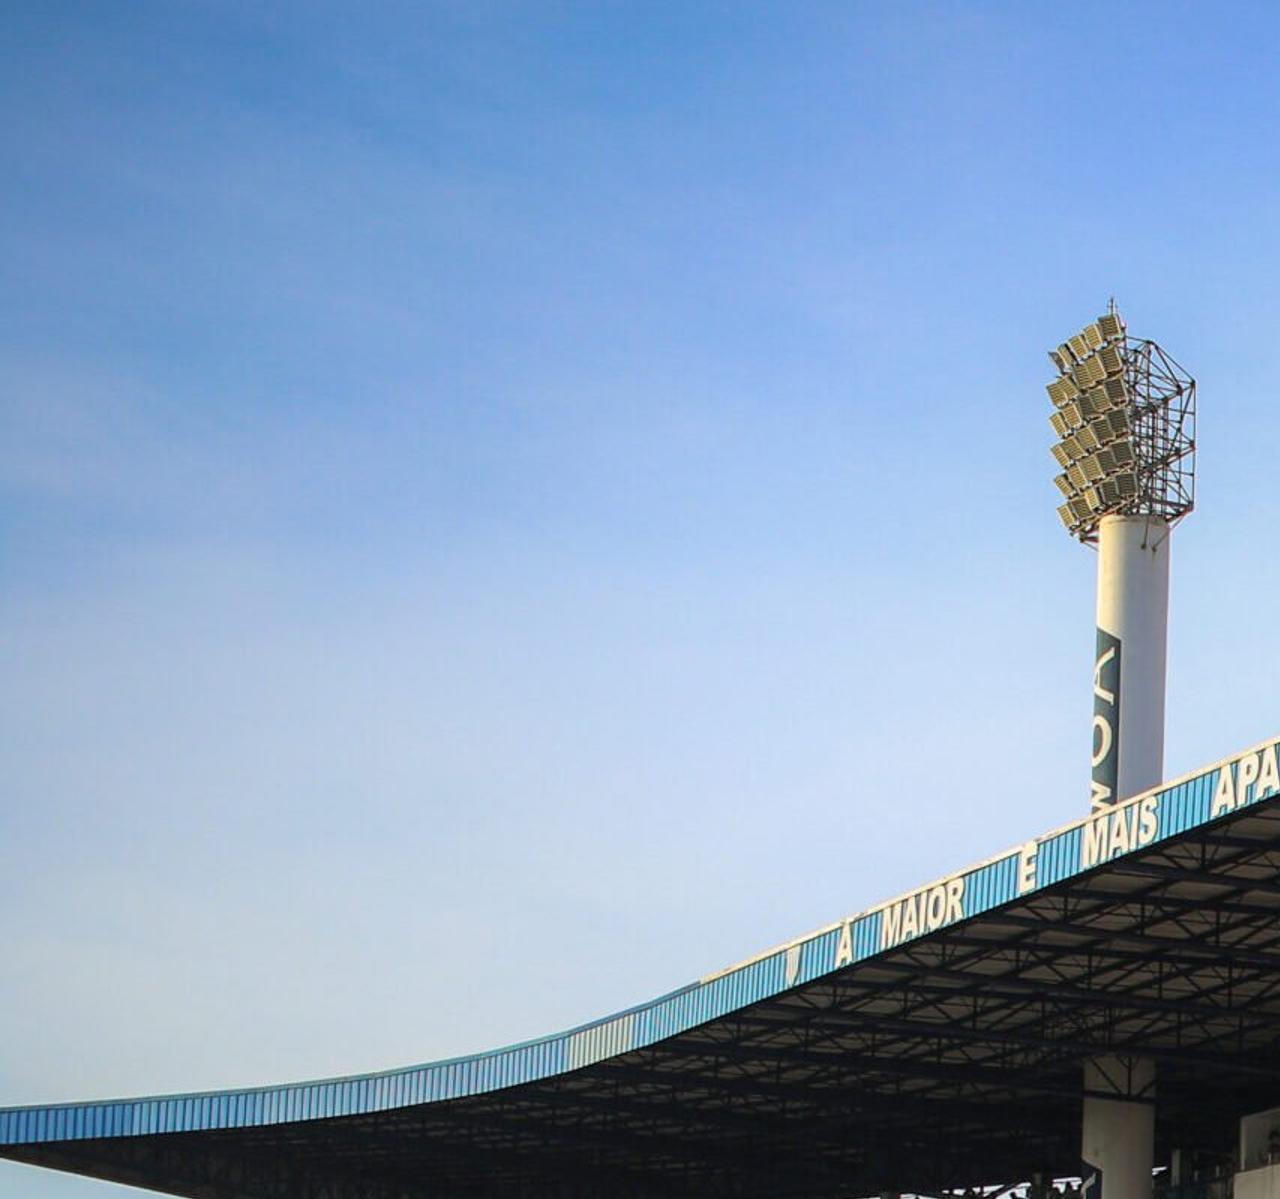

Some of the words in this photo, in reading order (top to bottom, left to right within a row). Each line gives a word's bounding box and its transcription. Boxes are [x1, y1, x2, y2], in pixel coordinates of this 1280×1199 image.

[833, 919, 853, 969] A
[880, 877, 965, 950] MAIOR
[1018, 843, 1038, 893] E
[1081, 796, 1159, 868] MAIS
